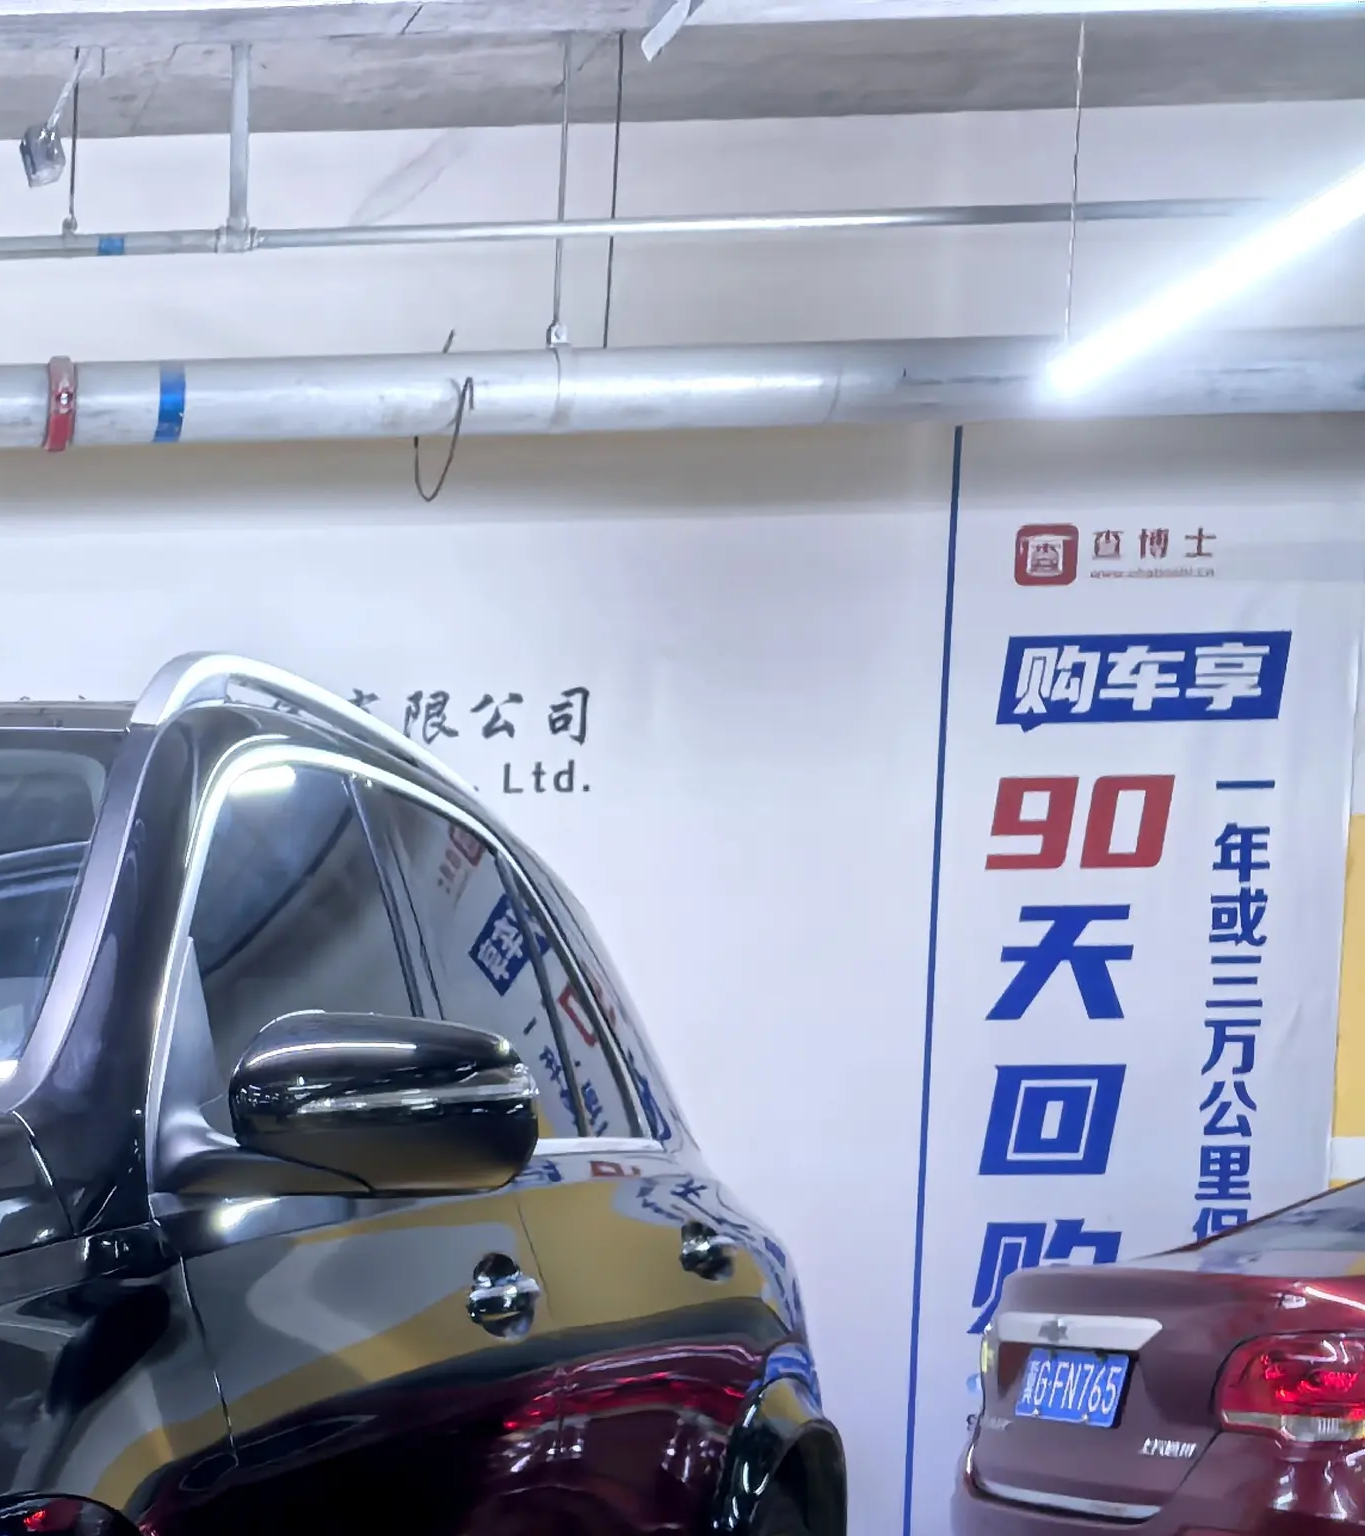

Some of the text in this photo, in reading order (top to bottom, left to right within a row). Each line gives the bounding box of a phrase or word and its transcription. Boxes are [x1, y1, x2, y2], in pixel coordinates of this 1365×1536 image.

[1012, 640, 1270, 716] 购车享
[503, 759, 591, 794] Ltd.
[984, 773, 1176, 871] 90
